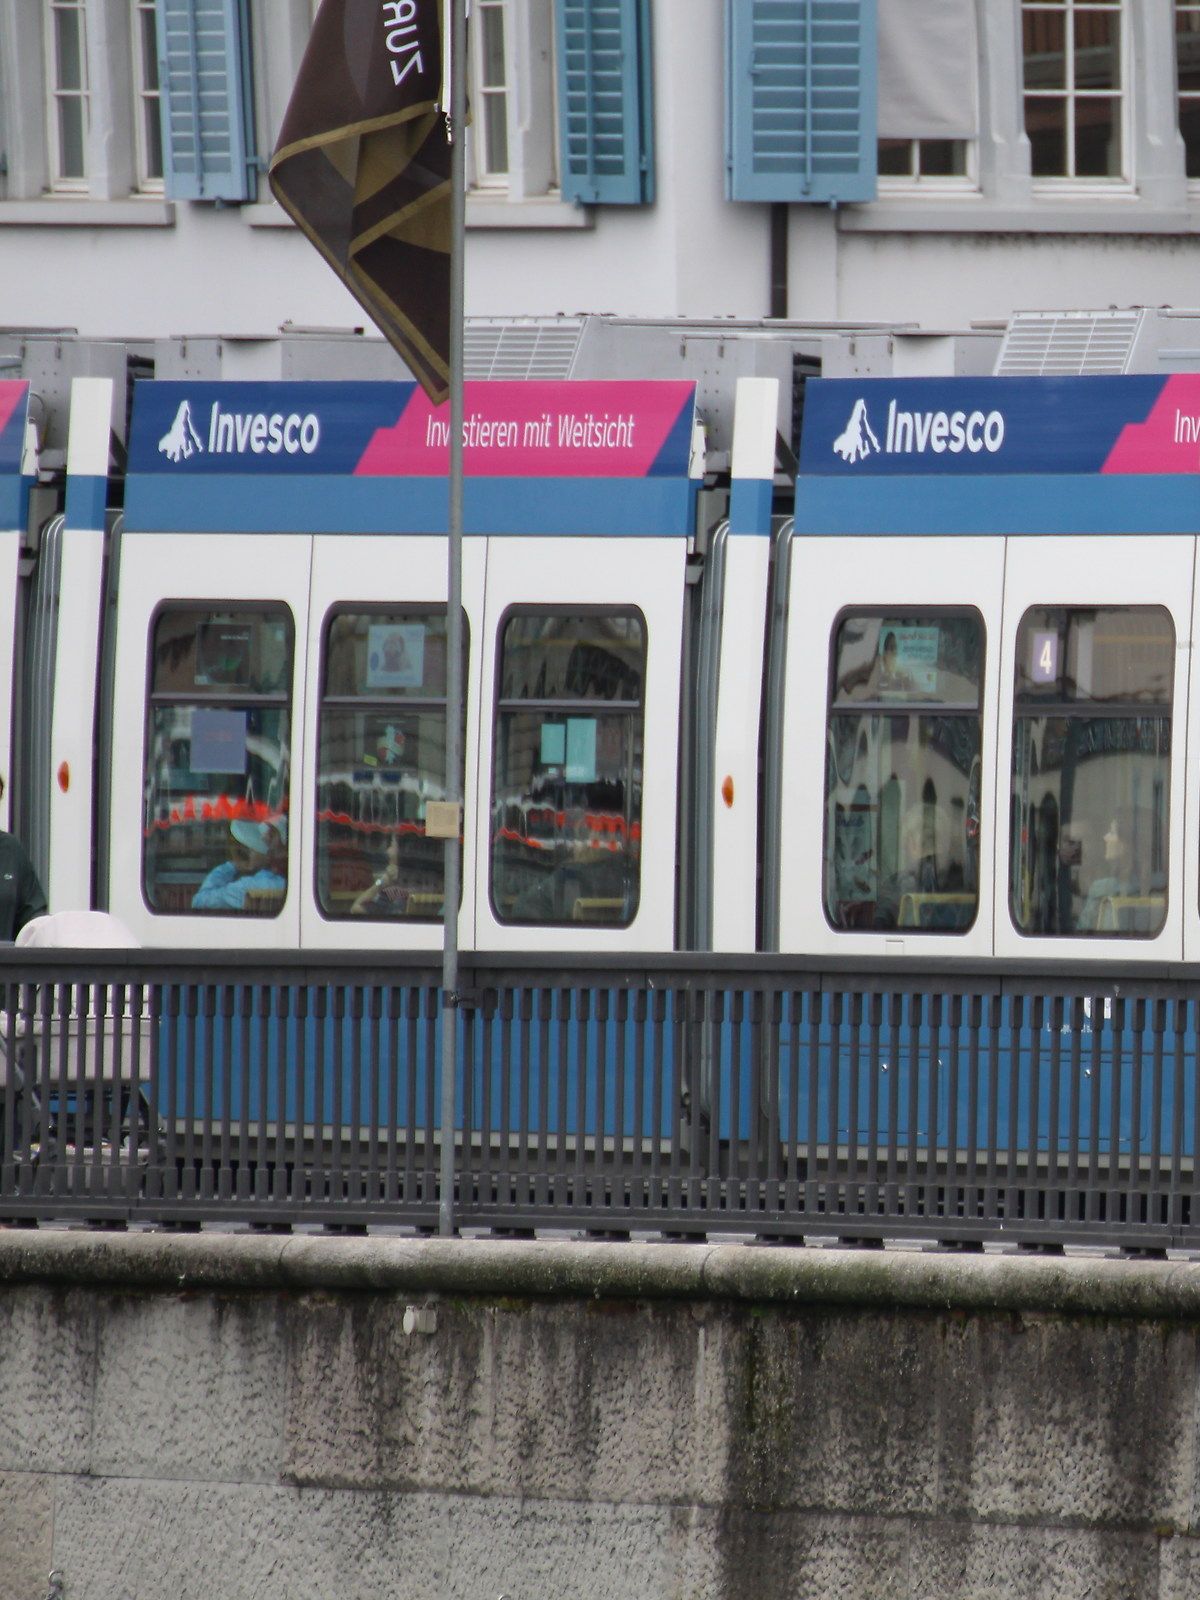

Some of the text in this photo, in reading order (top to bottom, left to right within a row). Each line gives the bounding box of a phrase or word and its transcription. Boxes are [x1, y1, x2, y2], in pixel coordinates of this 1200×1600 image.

[208, 400, 320, 454] Invesco
[426, 413, 635, 448] Invstieren mit Weitsicht
[886, 398, 1005, 453] Invesco
[1039, 640, 1052, 675] 4
